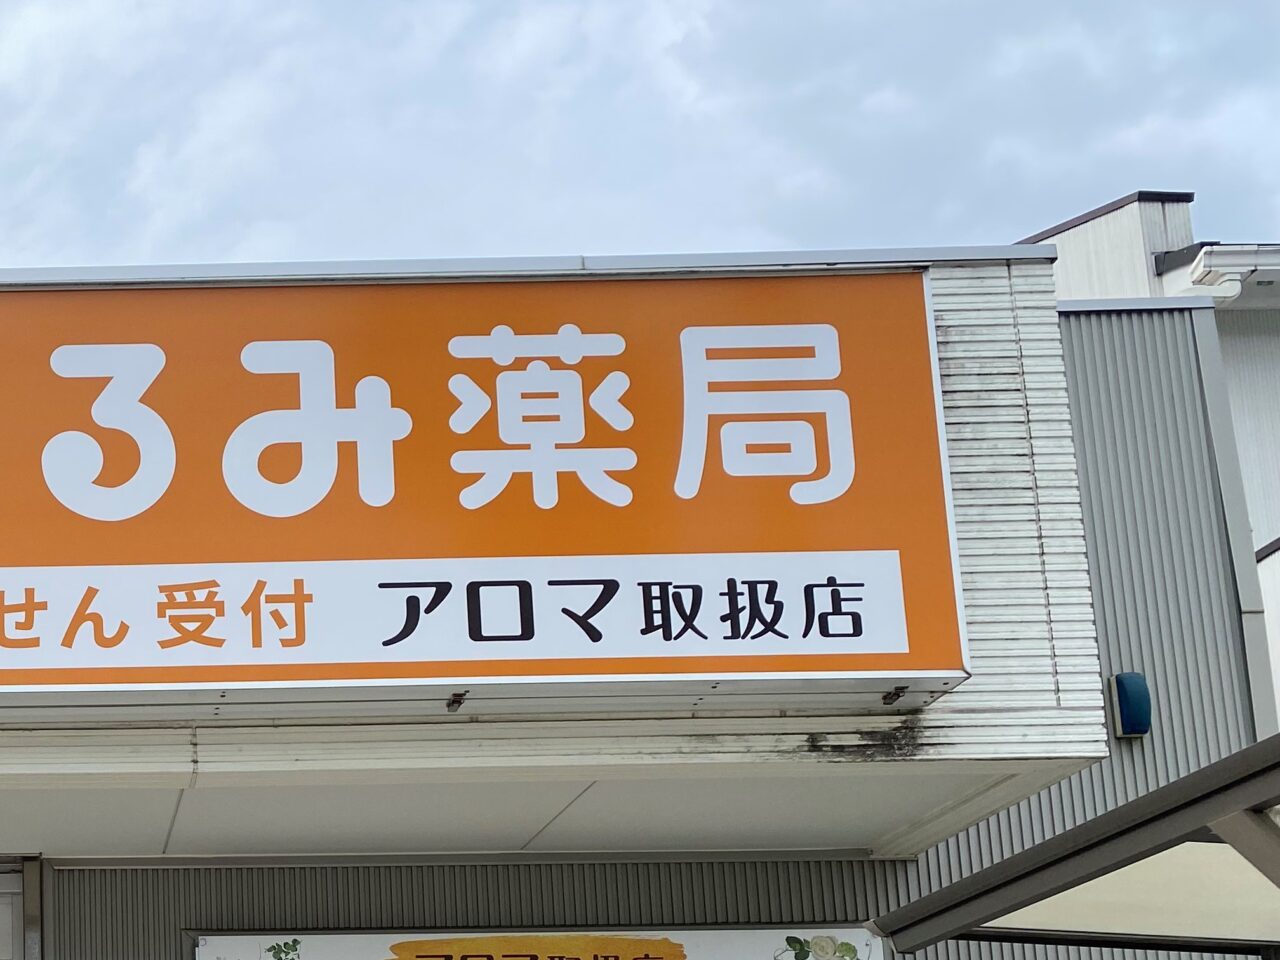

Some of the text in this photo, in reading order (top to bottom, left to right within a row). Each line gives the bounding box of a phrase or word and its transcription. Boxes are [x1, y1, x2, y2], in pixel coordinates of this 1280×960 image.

[376, 574, 866, 648] アロマ取扱店
